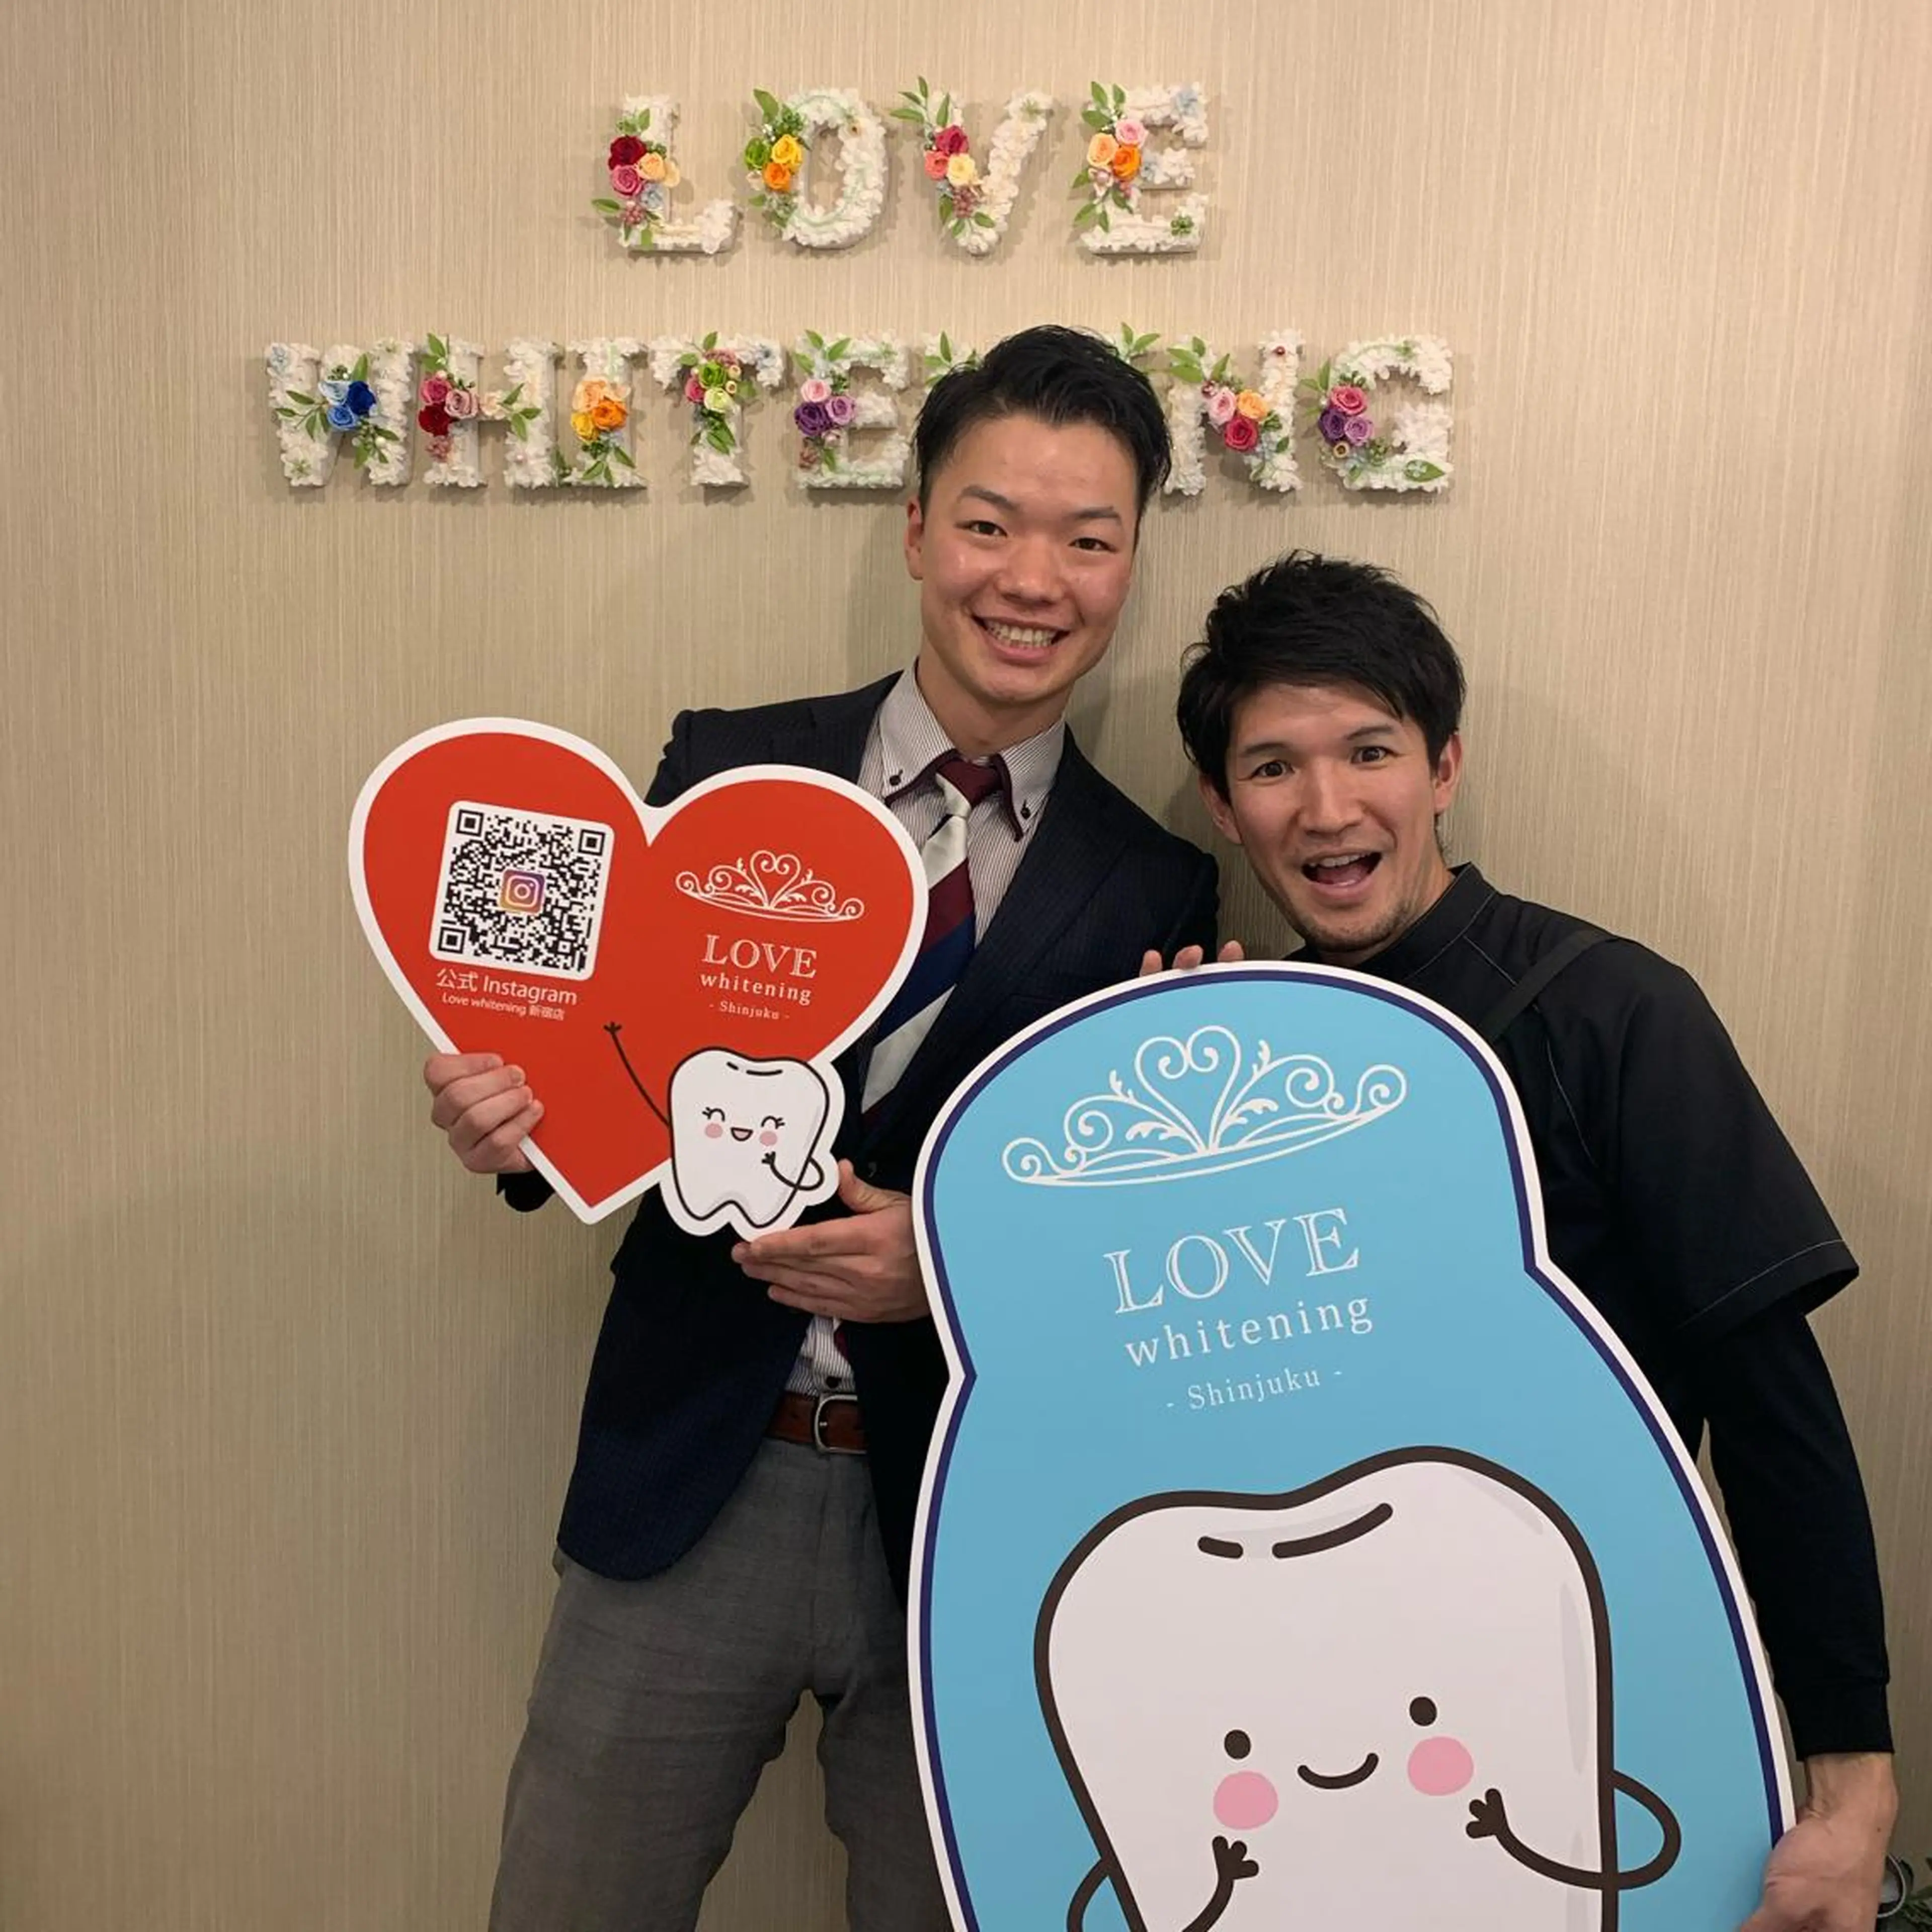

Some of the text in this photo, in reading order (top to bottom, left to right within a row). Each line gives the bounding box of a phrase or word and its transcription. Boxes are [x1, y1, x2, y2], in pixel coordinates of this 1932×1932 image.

[604, 80, 1212, 256] LOVE
[264, 330, 1455, 495] WHITENG
[701, 934, 817, 979] LOVE
[436, 968, 578, 1006] 公式 Instagram
[442, 992, 469, 1006] Love
[470, 998, 527, 1017] whitening
[700, 972, 812, 1006] whitening
[719, 1000, 780, 1020] Shinjuku
[1103, 1208, 1359, 1314] LOVE
[1125, 1298, 1374, 1367] whitening
[1187, 1367, 1320, 1411] Shinjuku
